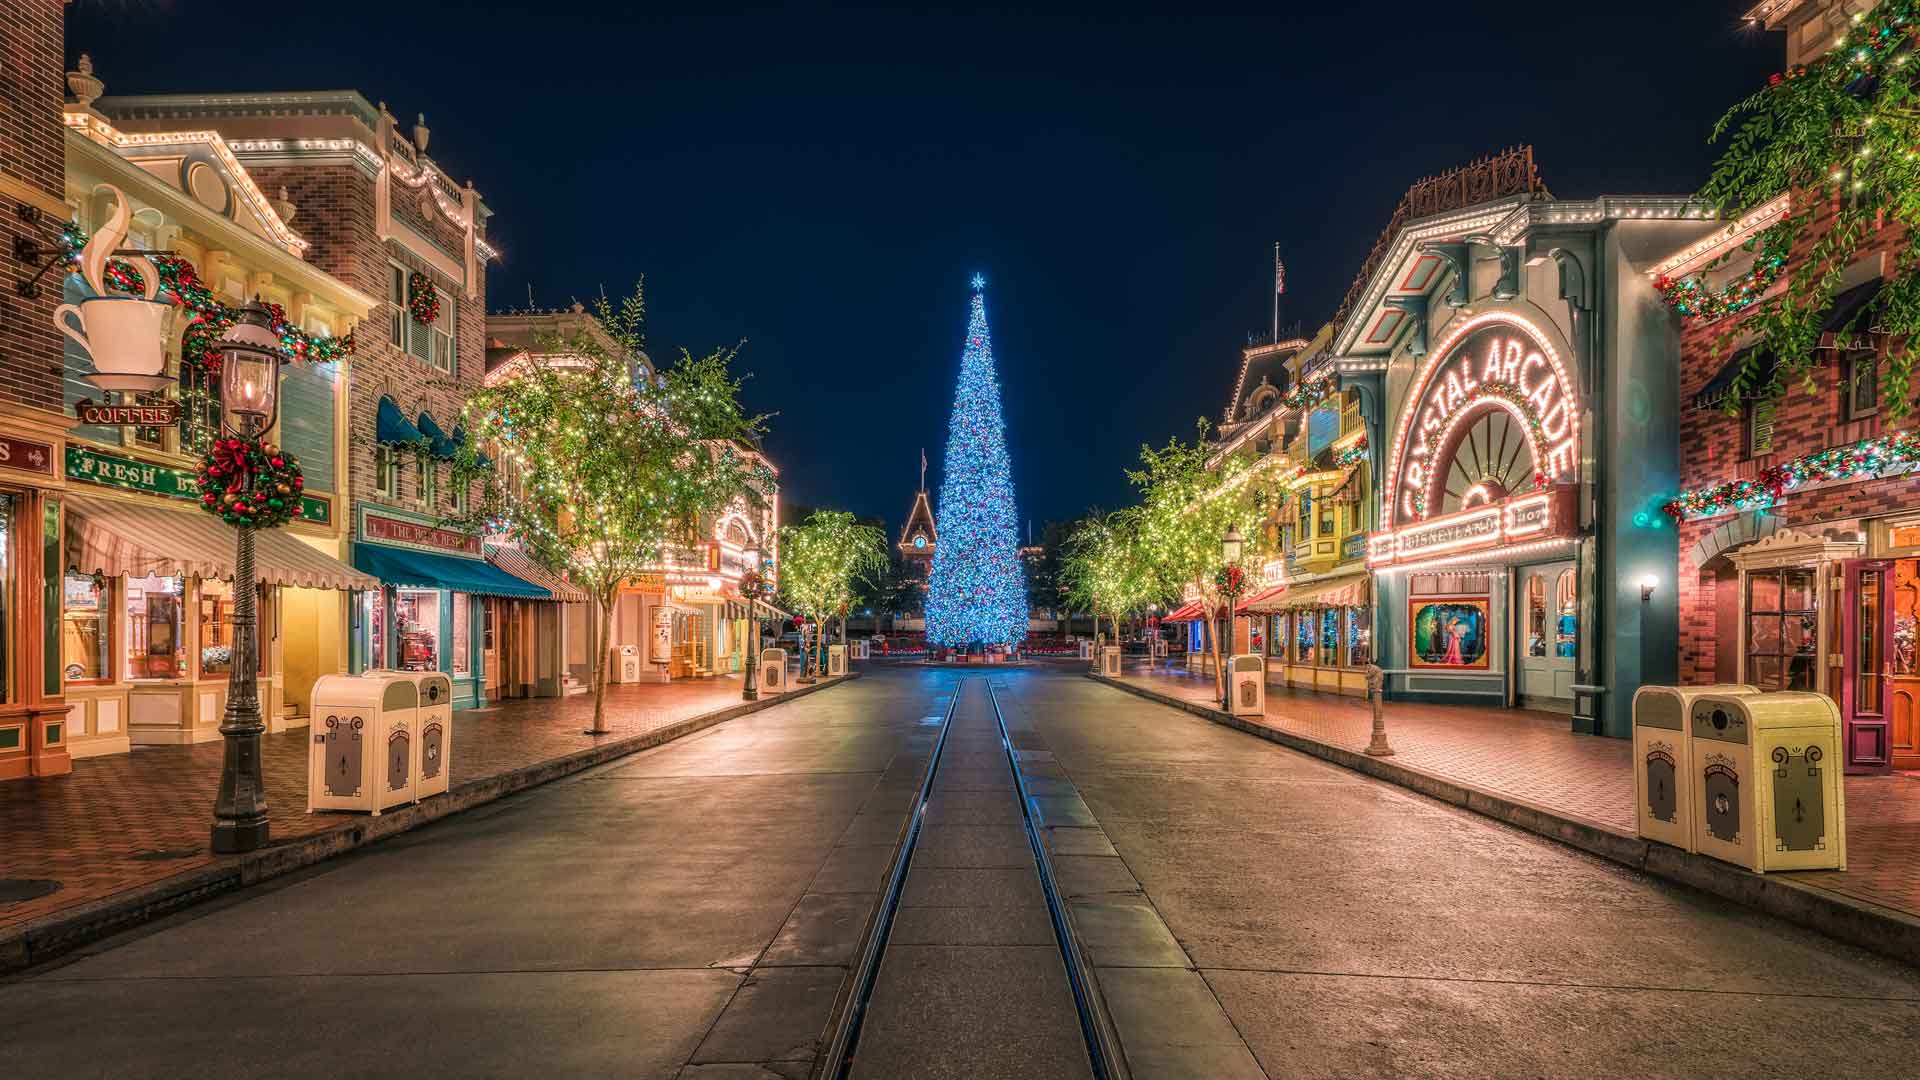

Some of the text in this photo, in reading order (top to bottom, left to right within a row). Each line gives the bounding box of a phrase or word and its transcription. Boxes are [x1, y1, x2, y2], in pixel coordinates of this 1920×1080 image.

[86, 407, 173, 424] COFFEE
[1482, 338, 1575, 481] ARCADE
[80, 457, 156, 486] FRESH
[391, 524, 410, 539] THE
[415, 528, 438, 545] BOK
